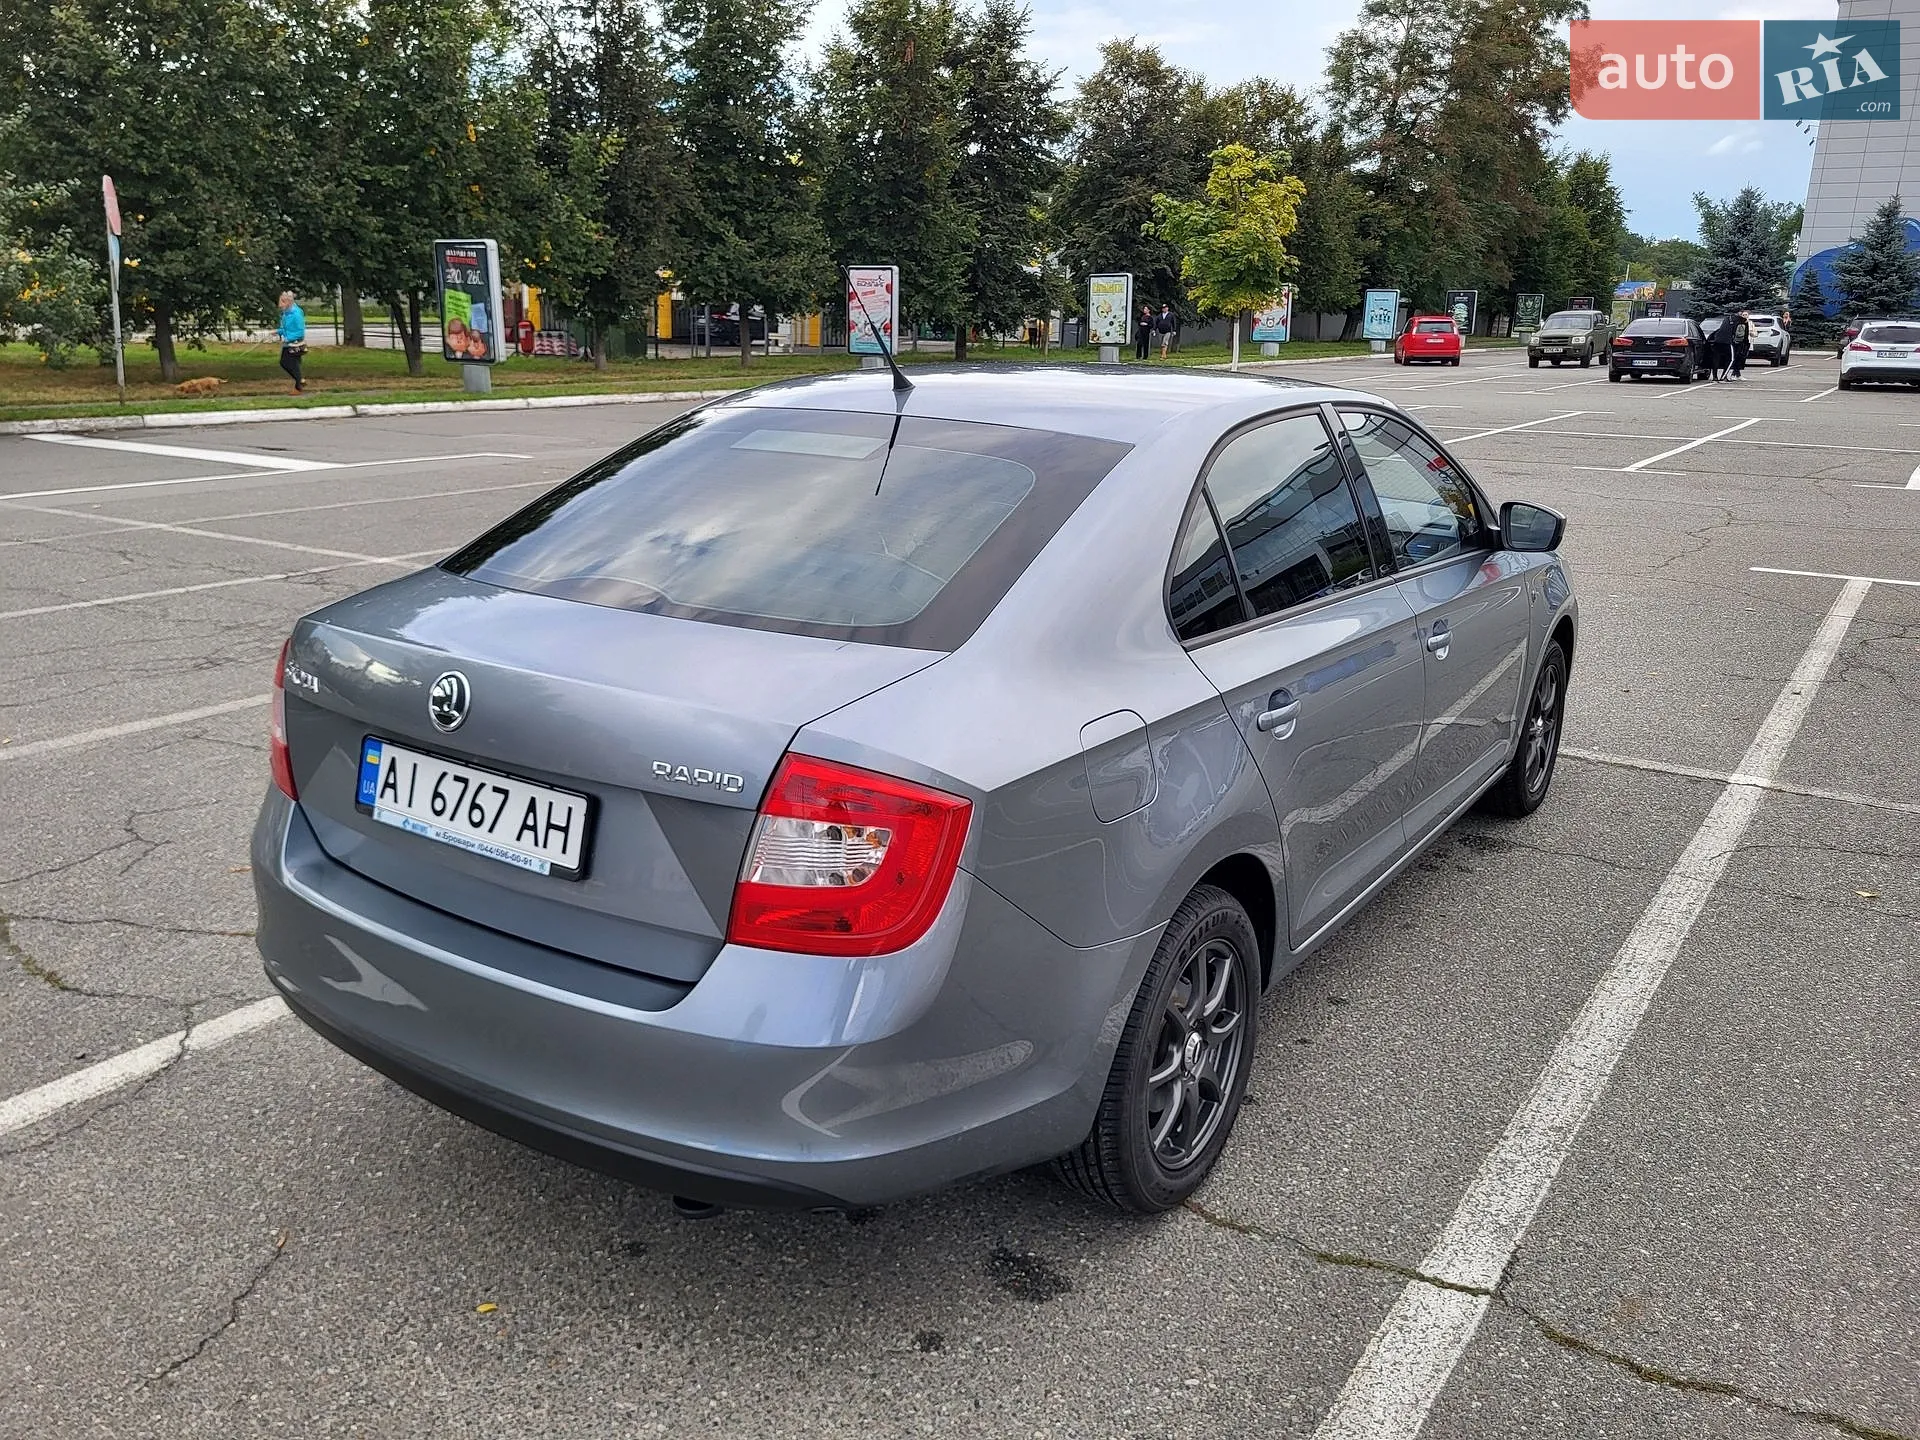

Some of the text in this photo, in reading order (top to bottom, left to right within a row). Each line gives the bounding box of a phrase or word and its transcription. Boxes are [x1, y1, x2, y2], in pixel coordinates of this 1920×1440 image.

[363, 780, 376, 794] UA
[652, 760, 744, 793] RAPID
[379, 756, 573, 855] AI 6767 AH
